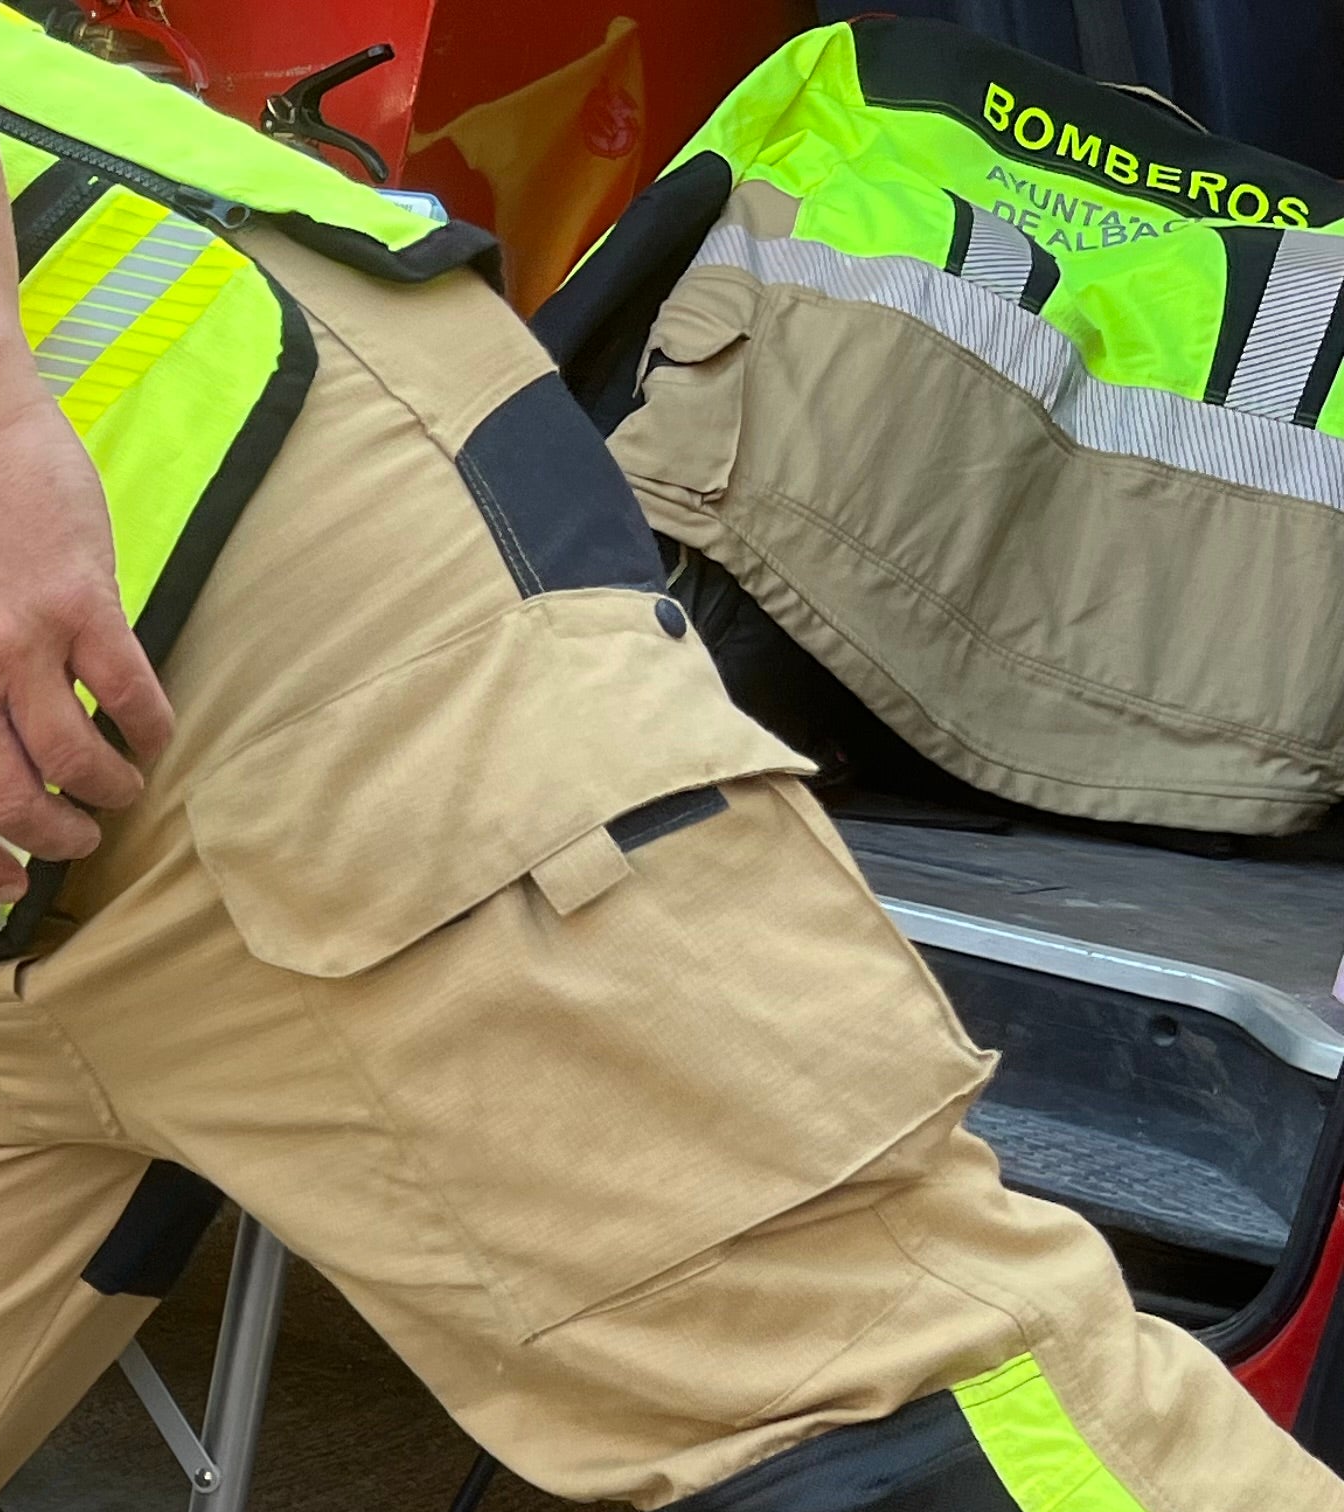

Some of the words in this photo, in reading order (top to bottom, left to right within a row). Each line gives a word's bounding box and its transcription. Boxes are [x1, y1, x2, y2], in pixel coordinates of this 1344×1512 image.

[983, 81, 1310, 229] BOMBEROS
[986, 165, 1141, 227] AYUNTA
[992, 200, 1041, 231] DE
